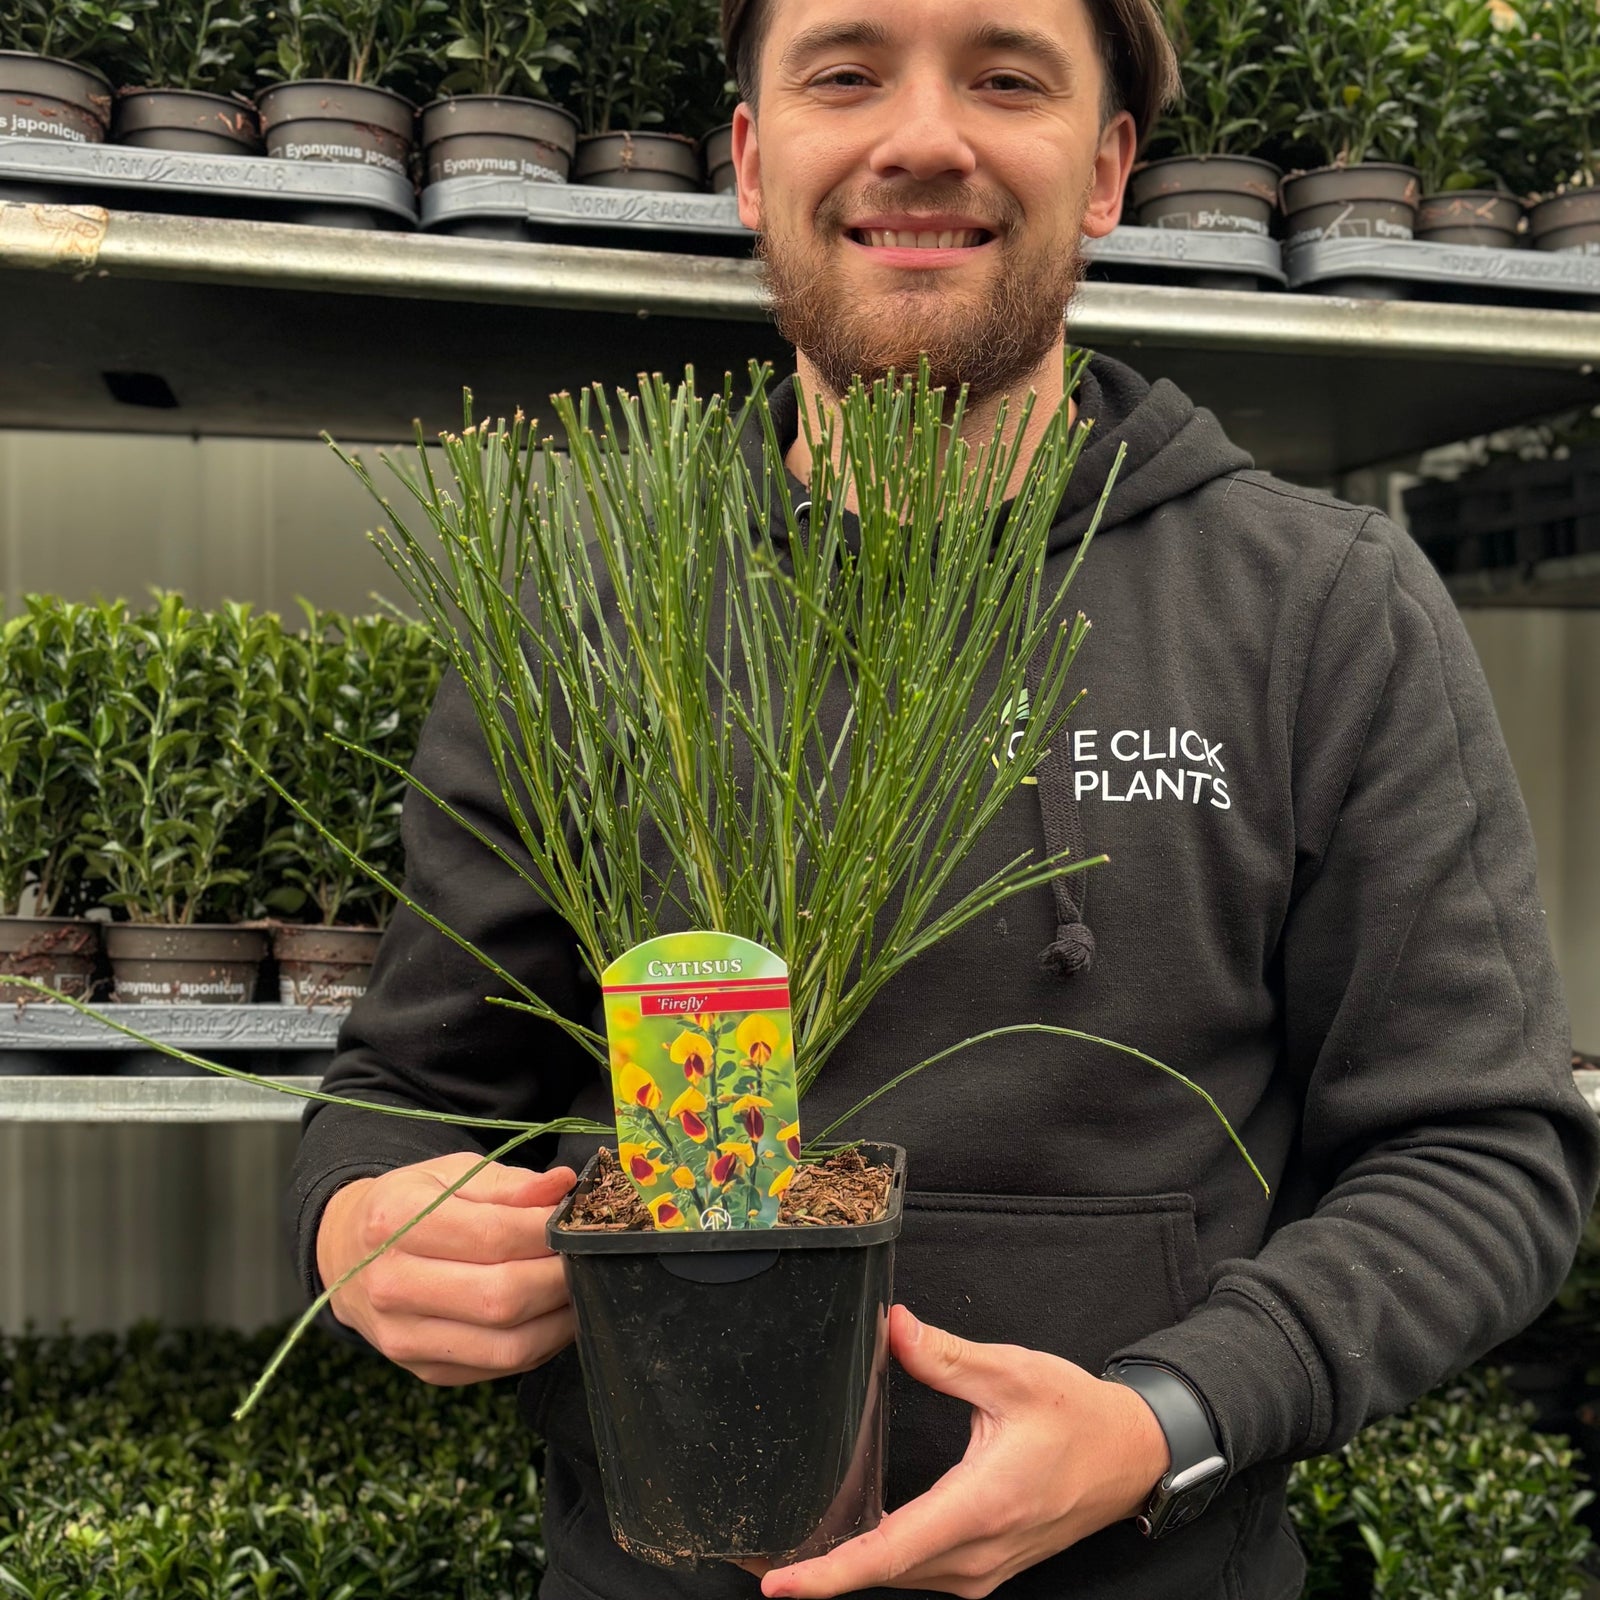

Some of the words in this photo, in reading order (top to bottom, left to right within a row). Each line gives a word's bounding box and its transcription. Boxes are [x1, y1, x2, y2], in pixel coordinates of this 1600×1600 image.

[11, 114, 87, 143] japonicus
[1110, 727, 1226, 772] CLICK
[1074, 768, 1232, 810] PLANTS
[656, 996, 709, 1012] 'Firefly'
